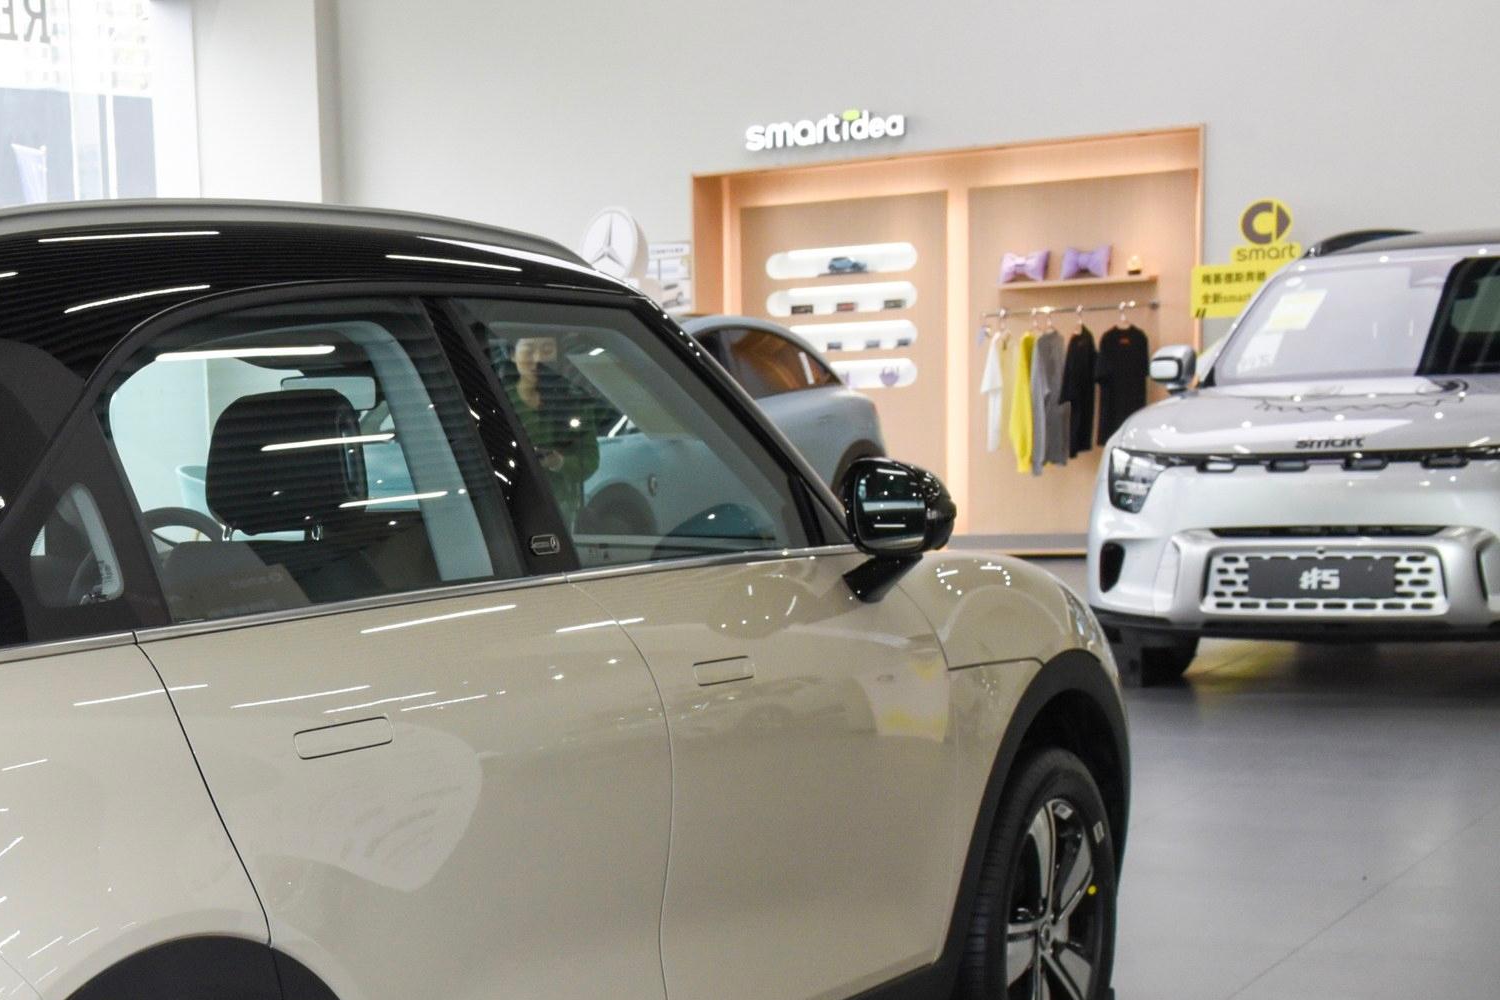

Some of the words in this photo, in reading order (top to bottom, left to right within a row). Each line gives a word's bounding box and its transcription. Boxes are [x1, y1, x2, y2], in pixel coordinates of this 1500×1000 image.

[1236, 244, 1297, 262] smart
[1295, 437, 1365, 449] smart
[1299, 566, 1341, 590] #5
